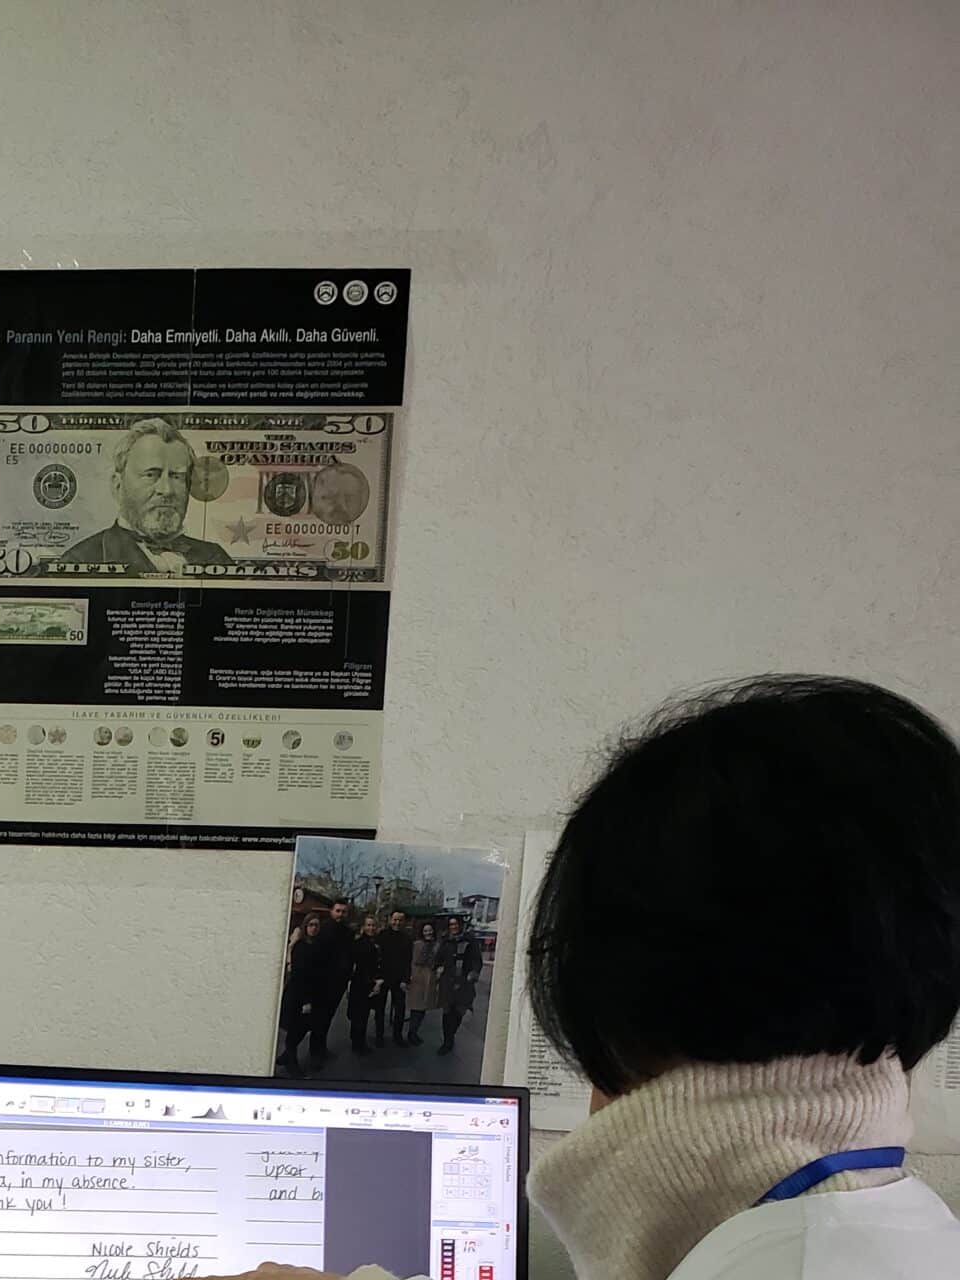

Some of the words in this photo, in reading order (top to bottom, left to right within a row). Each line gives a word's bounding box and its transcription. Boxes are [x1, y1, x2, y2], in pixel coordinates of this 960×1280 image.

[57, 330, 84, 344] Yeni
[87, 330, 127, 346] Rengi:
[131, 330, 162, 343] Daha
[166, 330, 221, 347] Emniyetli.
[225, 329, 256, 343] Daha
[259, 329, 292, 343] Akıllı.
[296, 329, 328, 343] Daha
[331, 328, 379, 343] Güvenli.
[323, 415, 385, 434] 50
[9, 442, 25, 454] EE
[28, 442, 92, 455] 00000000
[95, 443, 103, 455] T
[206, 441, 277, 453] UNITED
[279, 441, 357, 454] STATES
[247, 454, 340, 466] AMERICA
[266, 523, 281, 534] EE
[284, 523, 349, 535] 00000000
[331, 541, 370, 560] 50
[183, 563, 319, 577] DOLLARS
[69, 630, 84, 641] 50
[86, 1152, 104, 1167] to
[112, 1156, 136, 1176] my
[144, 1150, 193, 1174] sister,
[20, 1171, 34, 1188] in
[42, 1175, 65, 1196] my
[71, 1174, 137, 1190] absence.
[269, 1185, 298, 1201] and
[25, 1196, 54, 1216] you
[92, 1240, 135, 1257] Nicole
[146, 1237, 200, 1258] Shields
